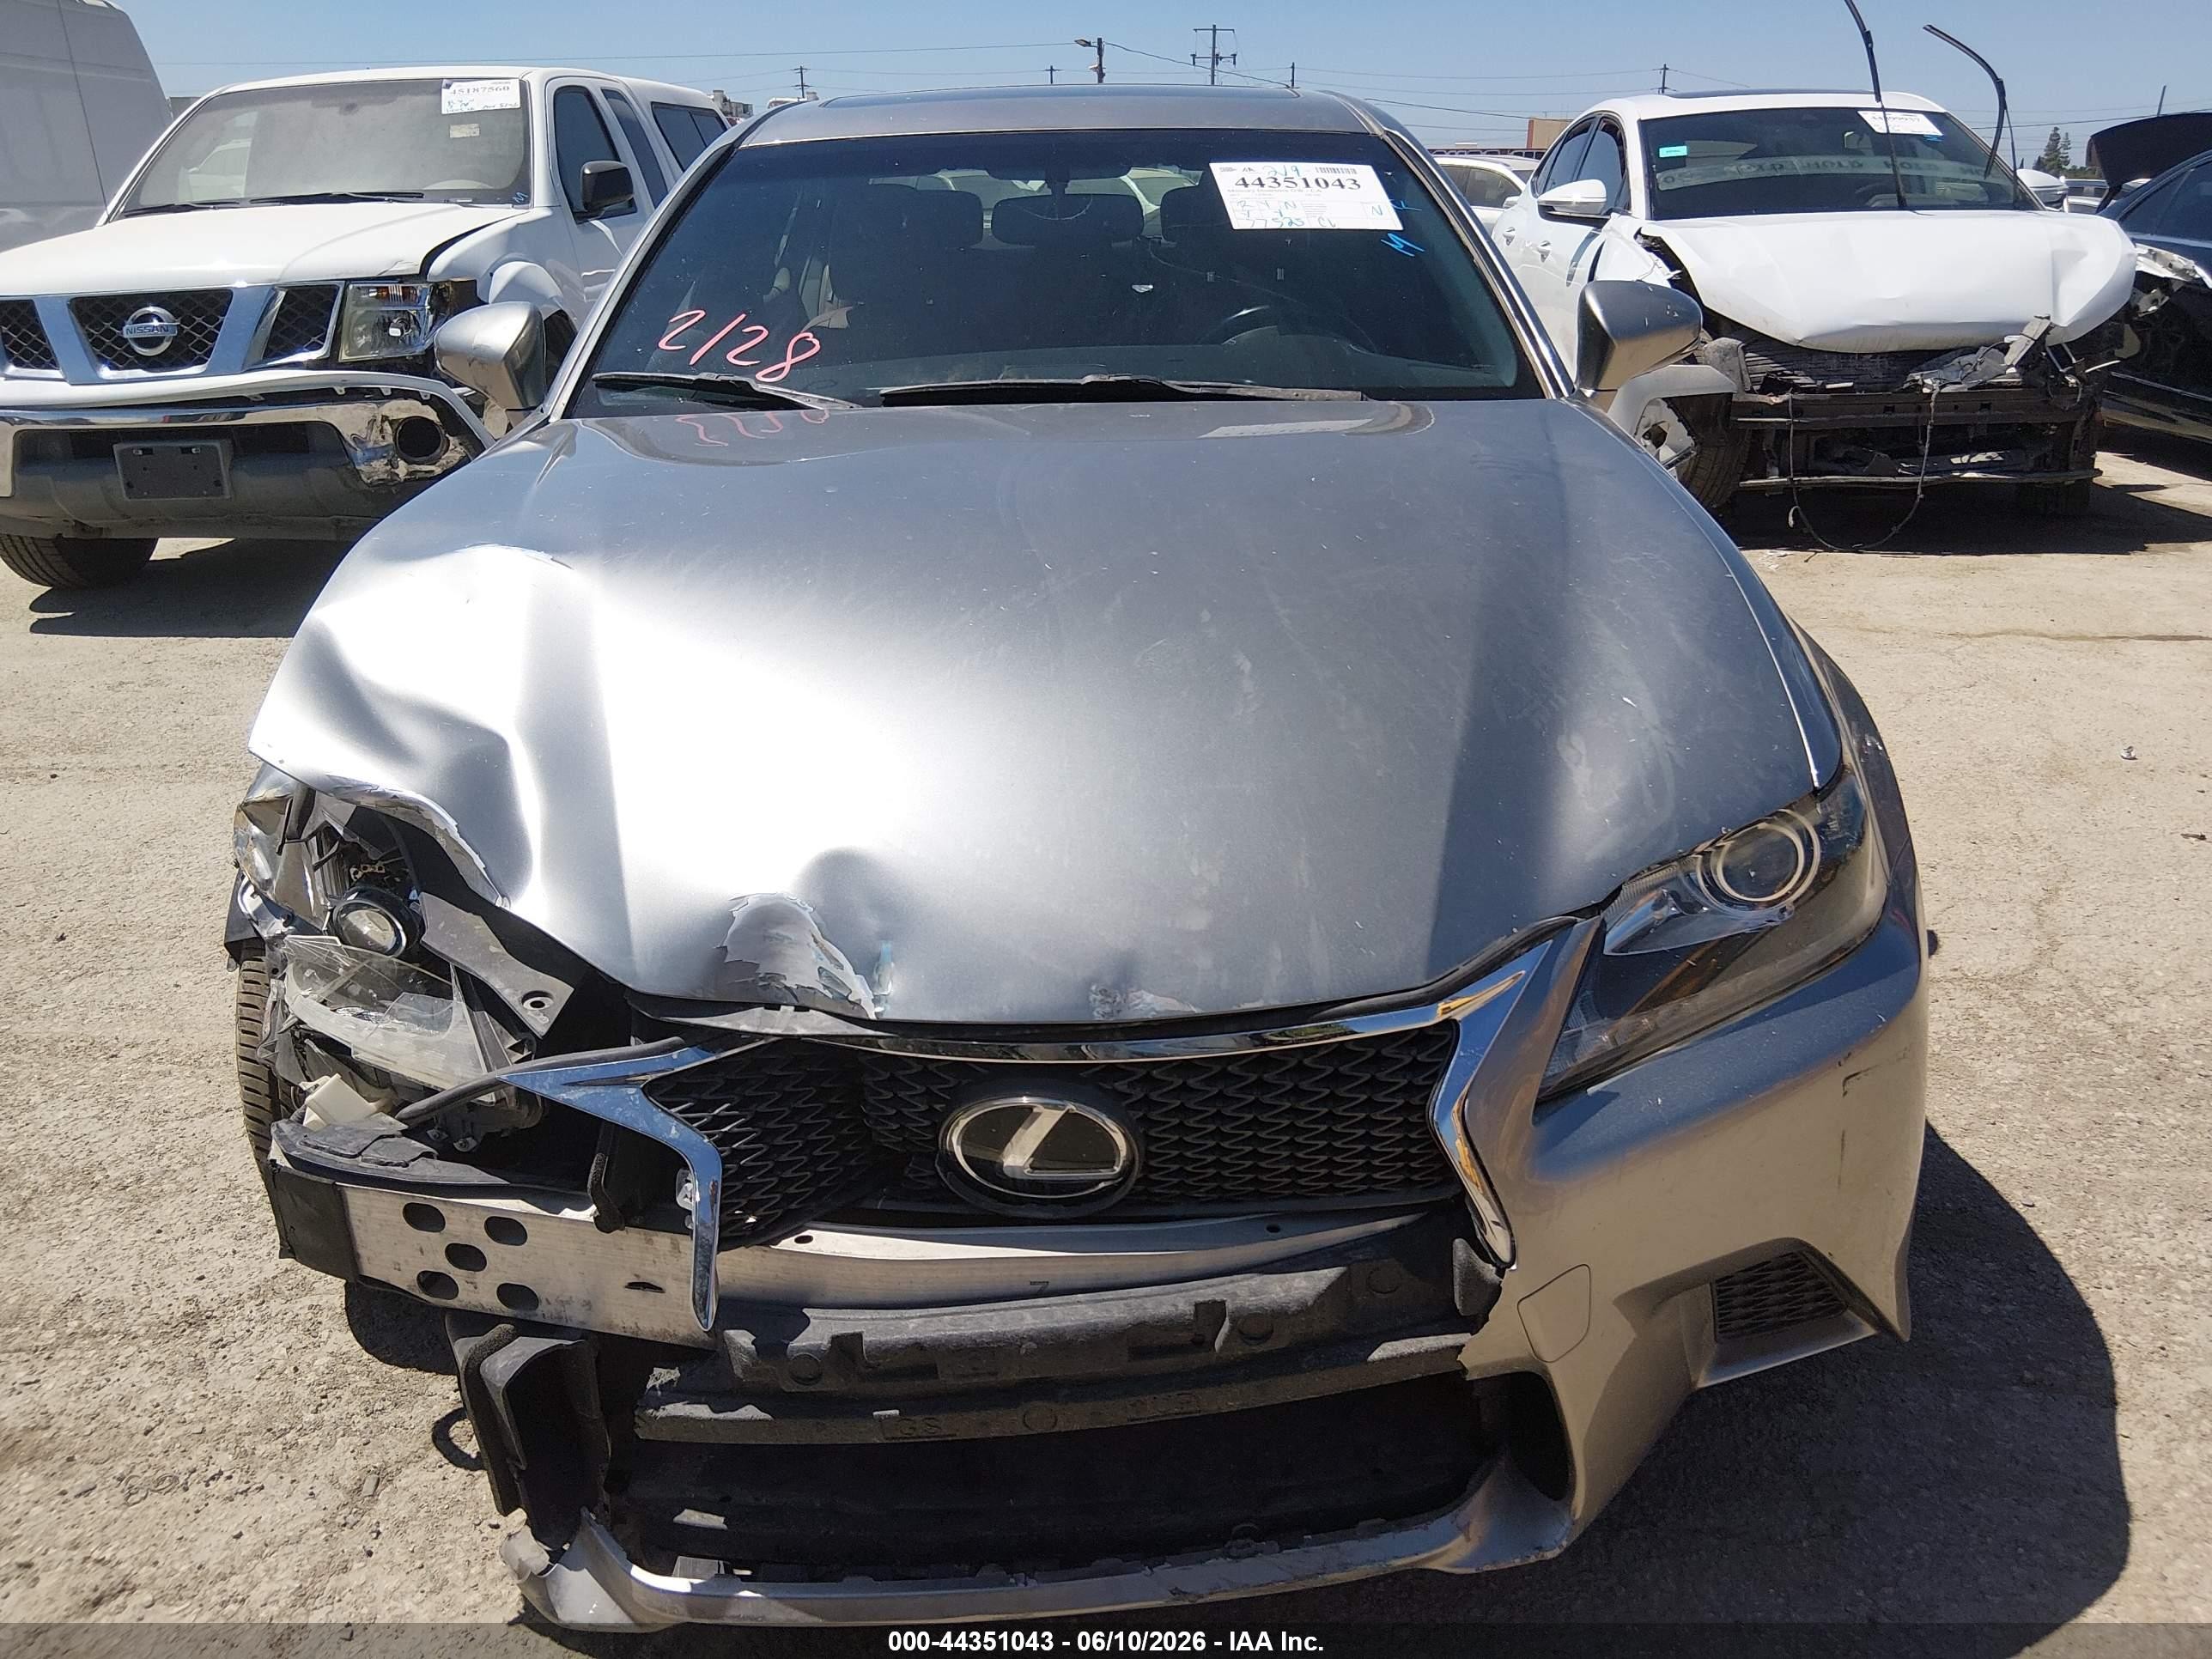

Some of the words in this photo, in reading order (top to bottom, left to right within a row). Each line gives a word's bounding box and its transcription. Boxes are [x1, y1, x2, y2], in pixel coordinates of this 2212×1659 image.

[1235, 176, 1361, 191] 44351043
[125, 325, 169, 336] NISSAN
[658, 309, 821, 383] 2/28
